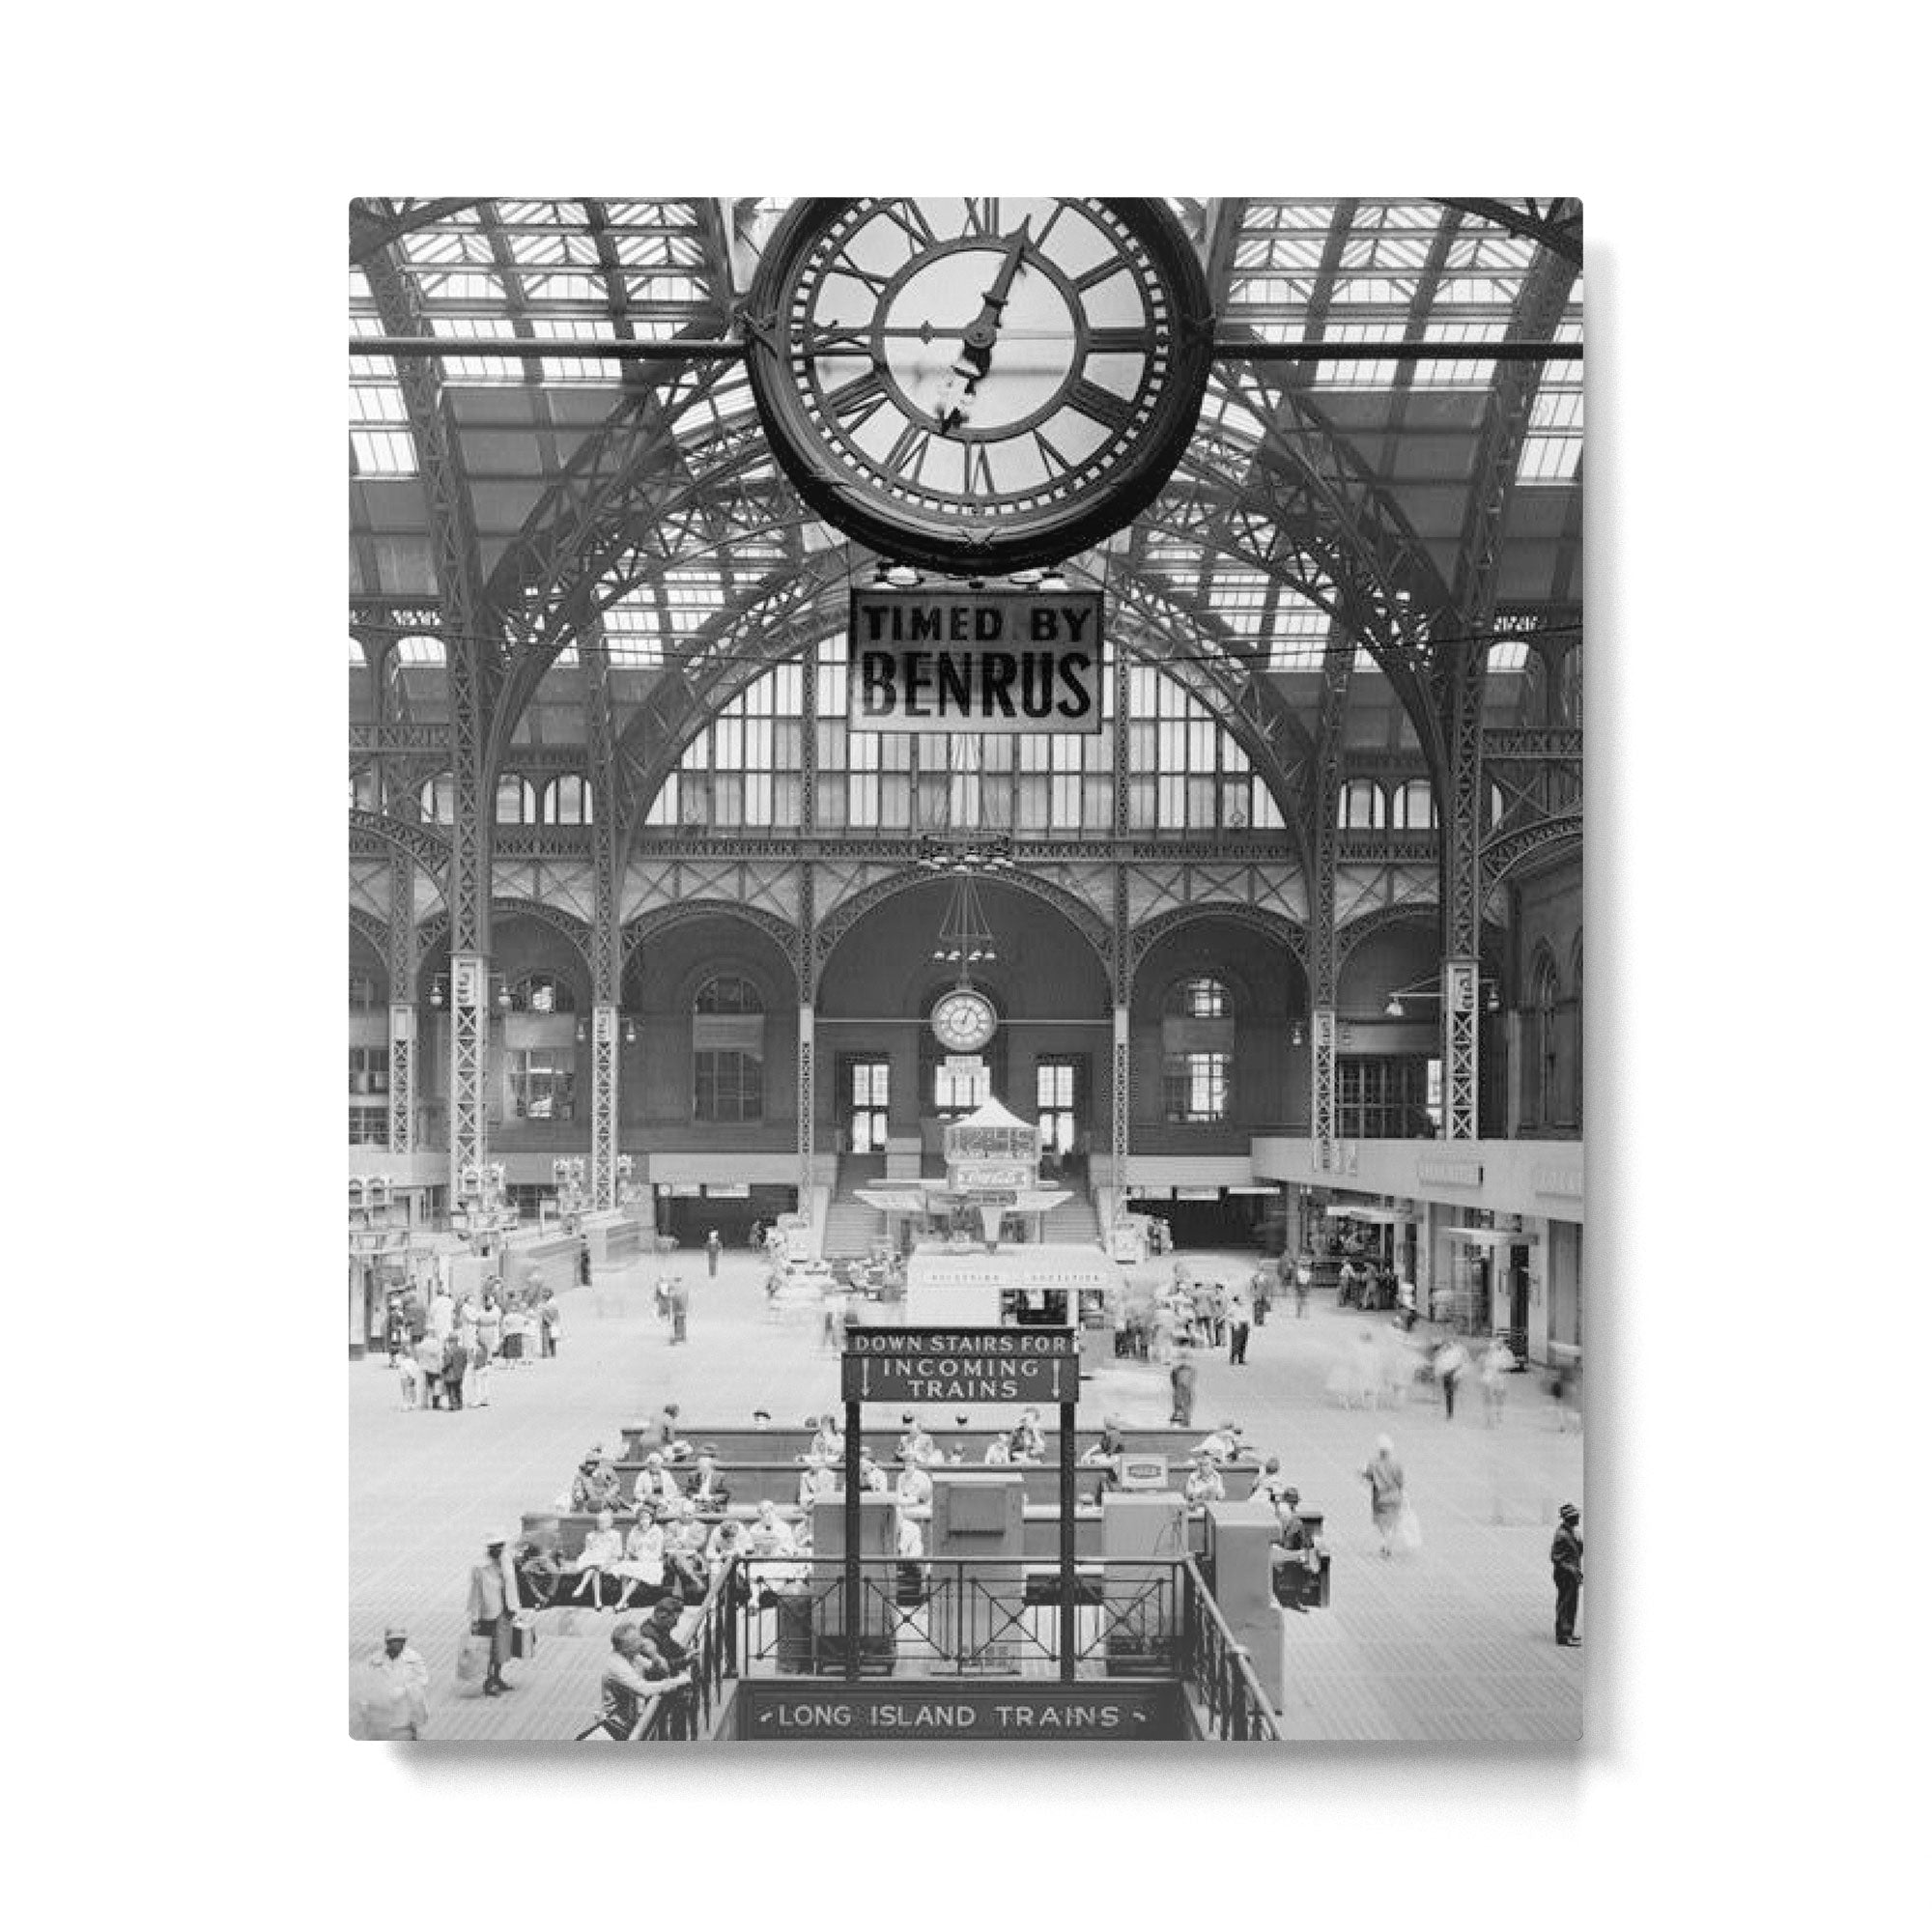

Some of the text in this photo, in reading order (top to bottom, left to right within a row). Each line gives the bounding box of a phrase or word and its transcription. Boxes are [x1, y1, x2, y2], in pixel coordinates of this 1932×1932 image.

[862, 606, 1093, 642] TIMED BY
[862, 651, 1092, 718] BENRUS
[854, 1335, 1067, 1351] DOWN STAIRS FOR
[883, 1358, 1039, 1377] INCOMING
[907, 1379, 1018, 1399] TRAINS
[778, 1704, 1121, 1727] LONG ISLAND TRAINS
